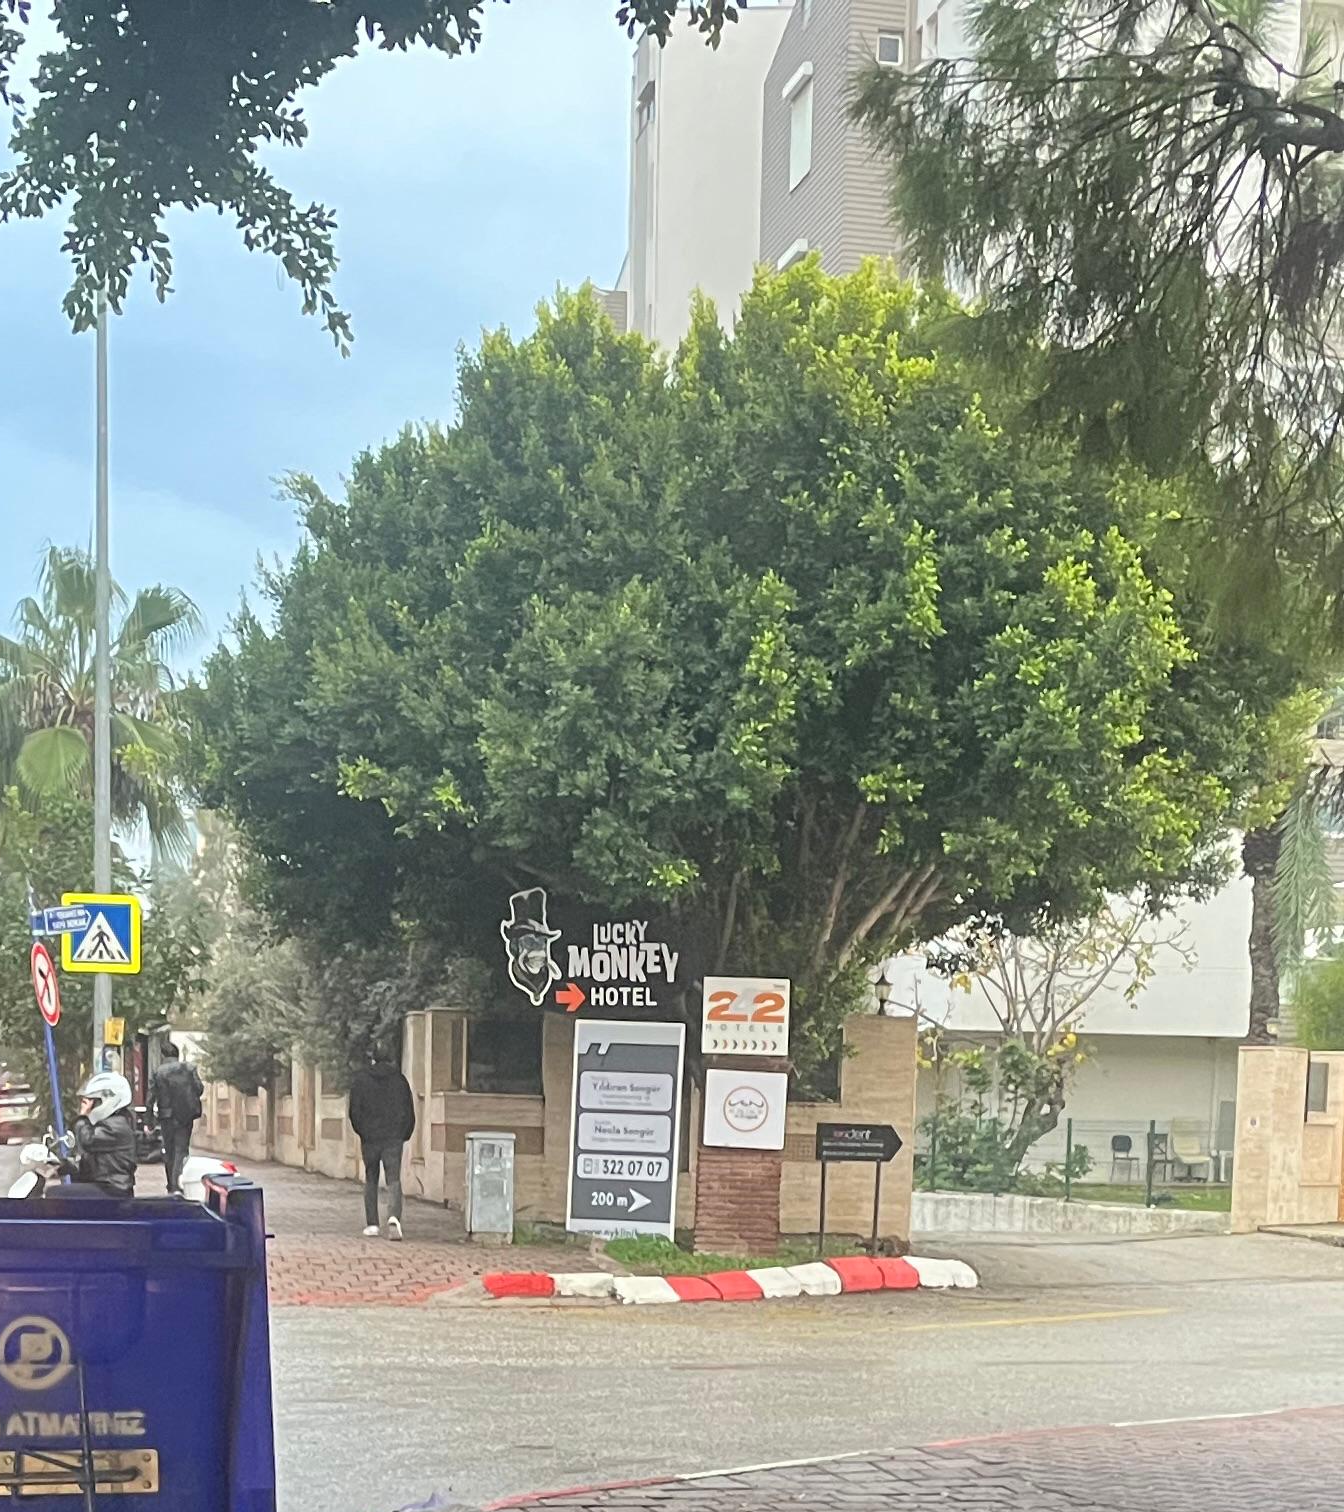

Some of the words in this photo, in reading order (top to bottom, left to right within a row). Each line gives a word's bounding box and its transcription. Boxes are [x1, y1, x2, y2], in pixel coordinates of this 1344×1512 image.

[593, 920, 648, 950] LUCKY
[567, 943, 678, 983] MONKEY
[590, 987, 657, 1006] HOTEL
[602, 1160, 624, 1175] 322
[628, 1160, 643, 1176] 07
[647, 1161, 662, 1177] 07
[591, 1191, 614, 1206] 200
[617, 1196, 628, 1207] m
